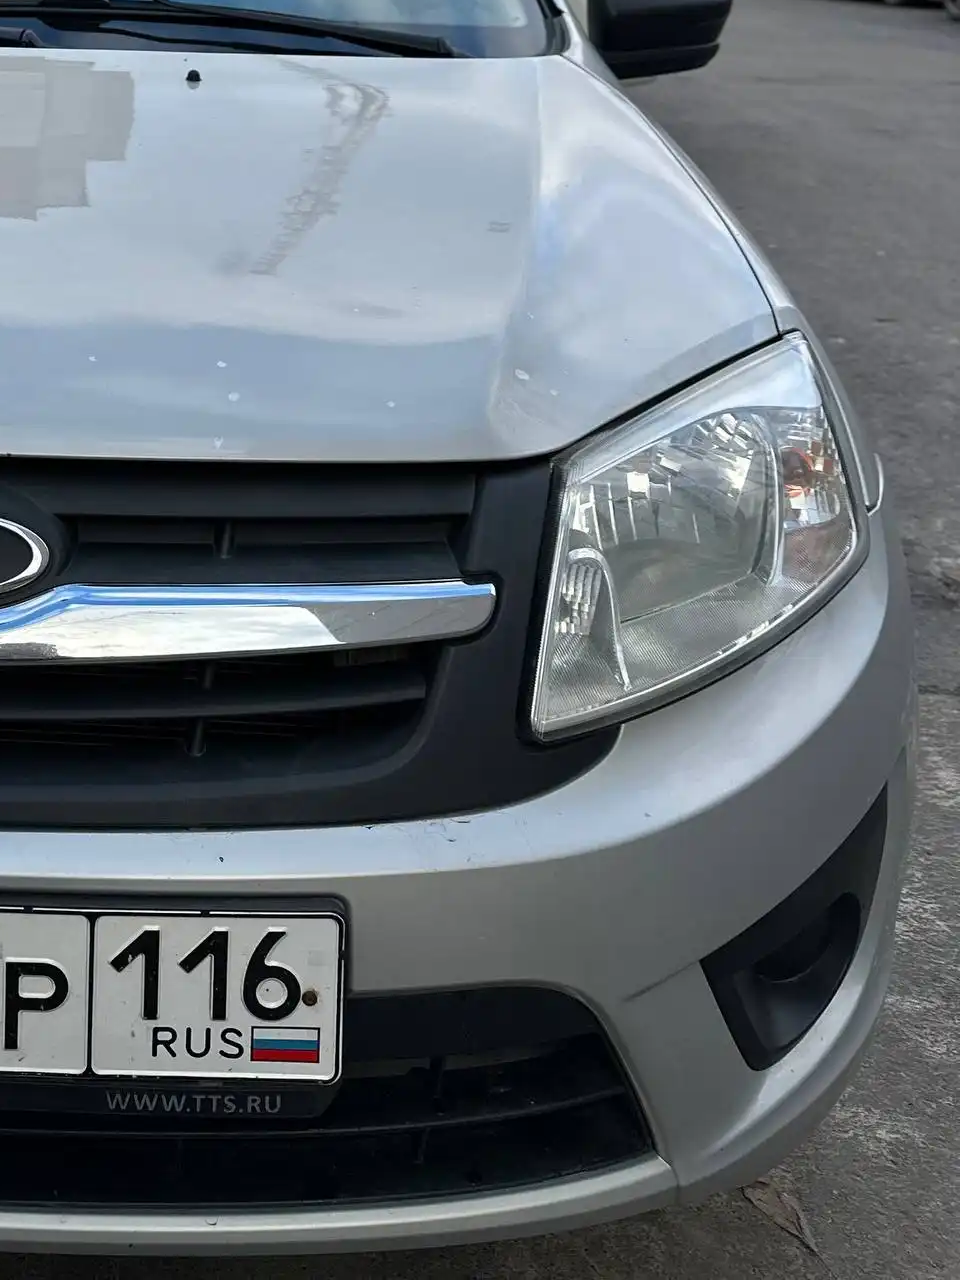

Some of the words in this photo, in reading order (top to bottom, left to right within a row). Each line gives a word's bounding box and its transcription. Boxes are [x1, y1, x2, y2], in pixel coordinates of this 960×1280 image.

[108, 926, 302, 1022] 116
[151, 1026, 245, 1059] RUS
[105, 1090, 282, 1114] WWW.TTS.RU
